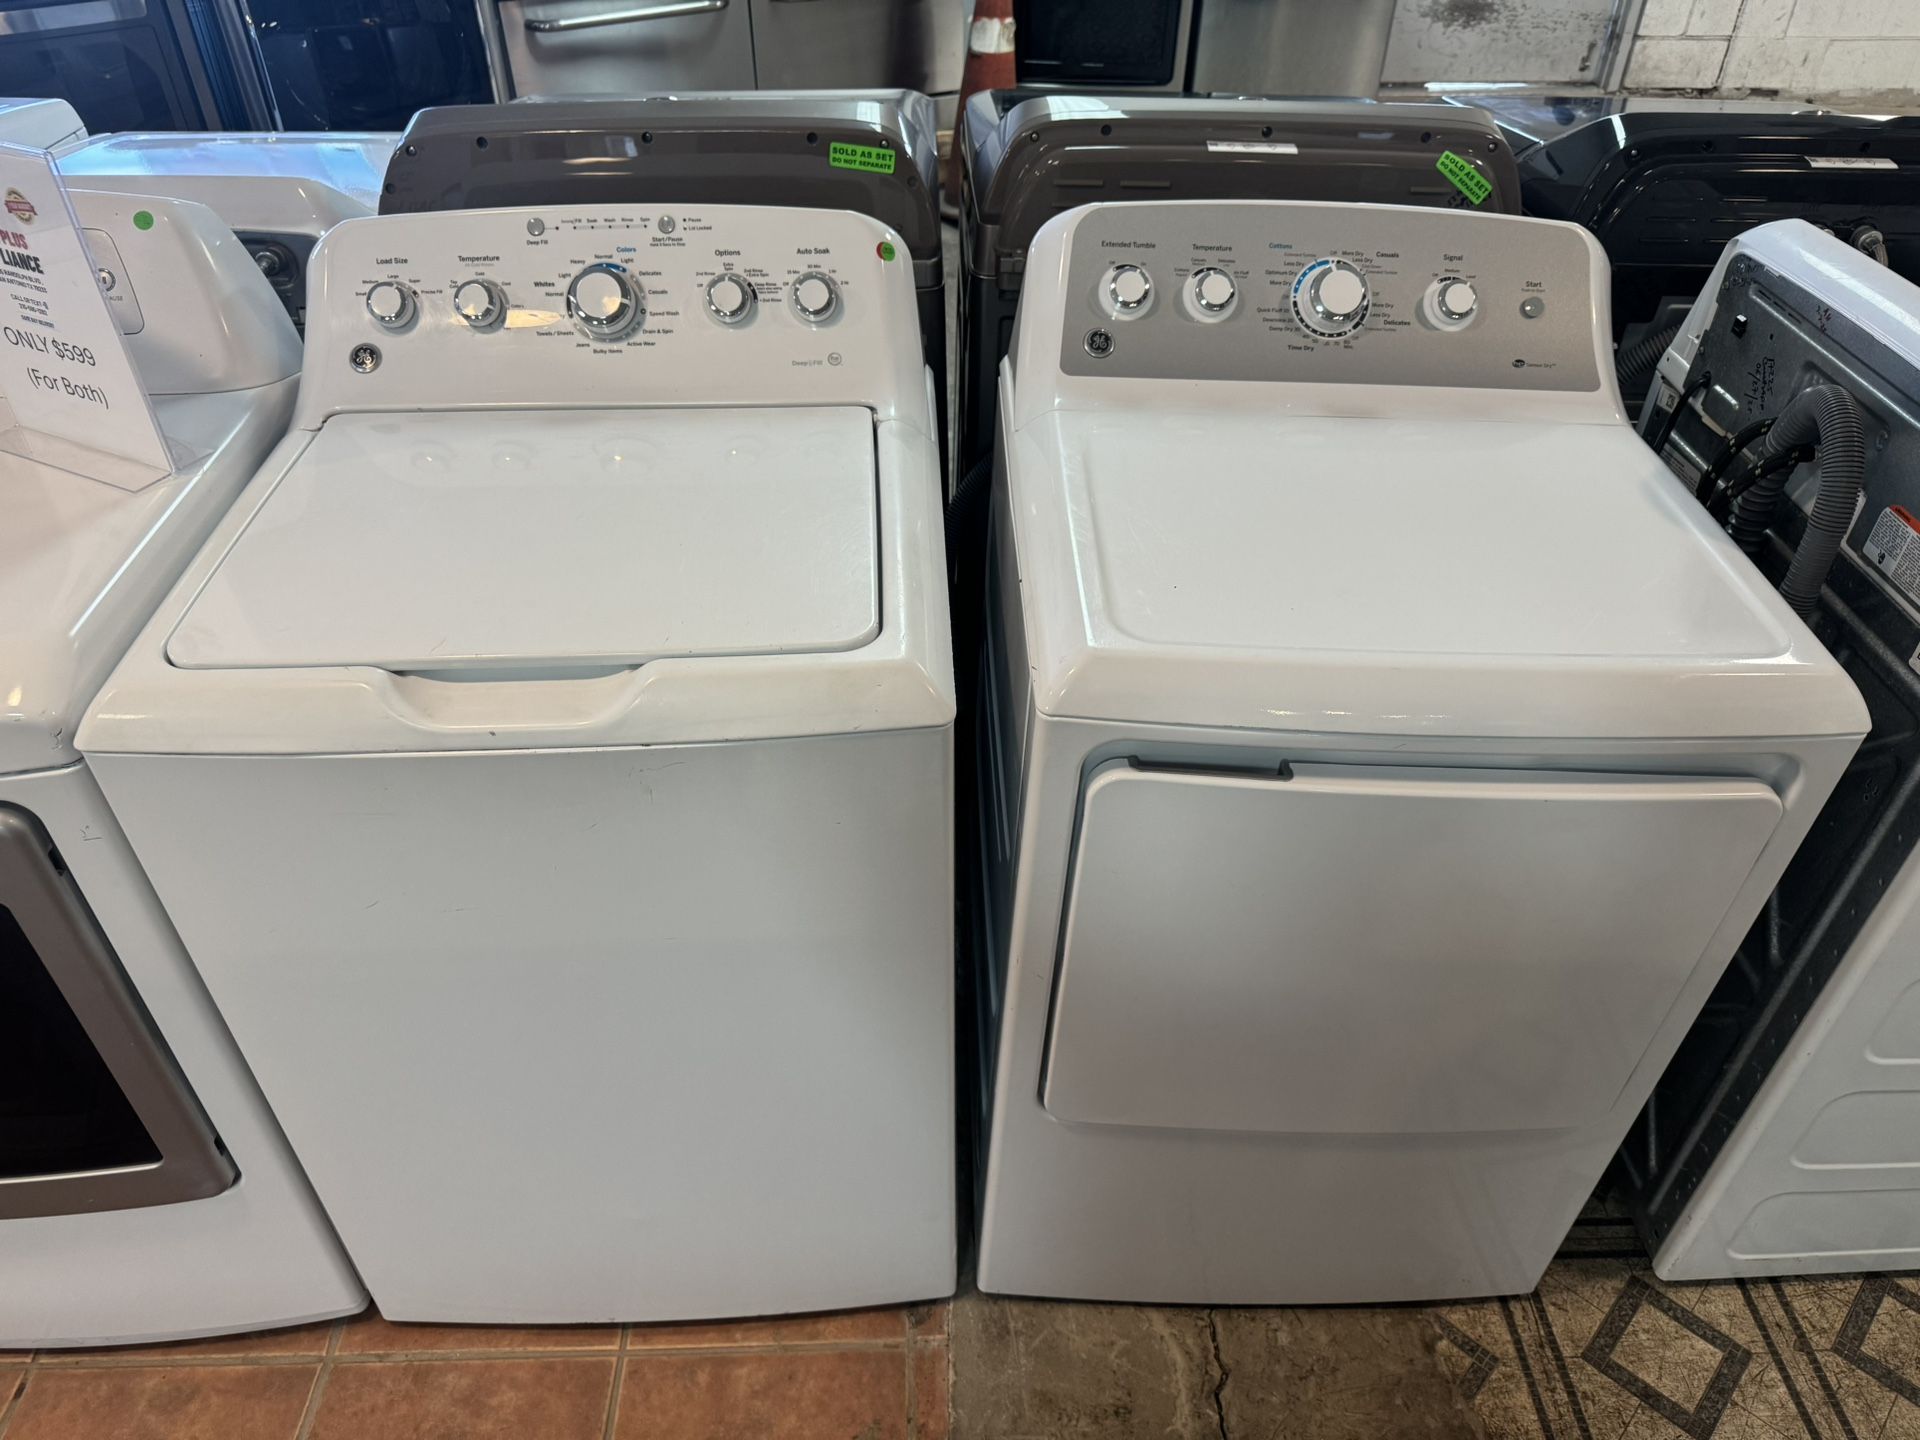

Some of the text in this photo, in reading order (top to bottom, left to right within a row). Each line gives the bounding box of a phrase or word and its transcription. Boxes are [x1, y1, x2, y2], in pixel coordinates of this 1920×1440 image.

[832, 146, 894, 162] SOLD AS SET
[858, 160, 892, 170] SEPARATE
[1444, 154, 1488, 194] SOLD AS SET
[0, 229, 28, 250] PLUS
[714, 249, 741, 257] Options
[1443, 254, 1464, 262] Signal
[4, 326, 96, 366] ONLY $599
[27, 367, 109, 410] (For Both)
